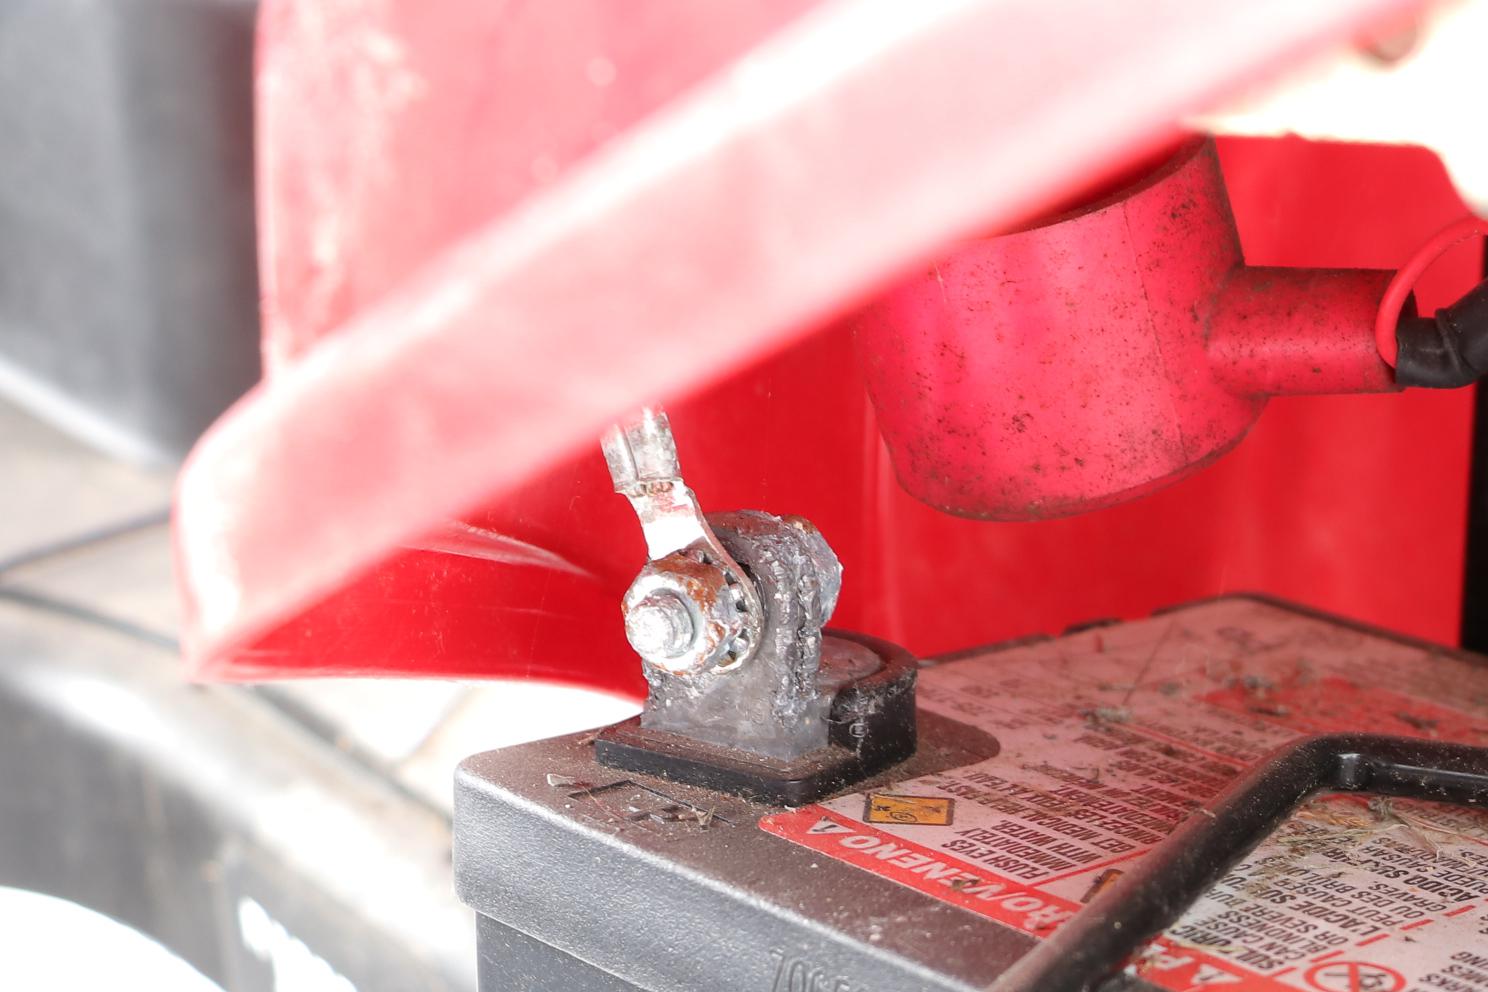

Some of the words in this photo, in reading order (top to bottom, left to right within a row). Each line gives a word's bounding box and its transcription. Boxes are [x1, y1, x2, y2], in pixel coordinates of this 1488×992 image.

[928, 780, 994, 800] FAST.
[980, 819, 1064, 846] WATER.
[1012, 810, 1107, 841] MEDICAL
[1090, 817, 1168, 844] RINCEZ
[935, 838, 999, 859] EYES
[952, 825, 1081, 872] IMMEDIATELY
[1041, 842, 1108, 863] WITH
[1086, 836, 1141, 854] GET
[977, 854, 1053, 879] FLUSH
[1267, 877, 1359, 907] CAUSER
[1345, 890, 1399, 907] DES
[1359, 880, 1450, 912] GRAVES.
[1232, 903, 1324, 934] SEVERE
[1285, 900, 1384, 936] L'ACIDE
[1341, 904, 1407, 926] PEUT
[1385, 905, 1428, 919] OU
[1187, 916, 1271, 944] CAUSE
[1212, 909, 1333, 953] BLINDNESS
[1307, 930, 1354, 946] OR
[1253, 941, 1313, 961] CAN
